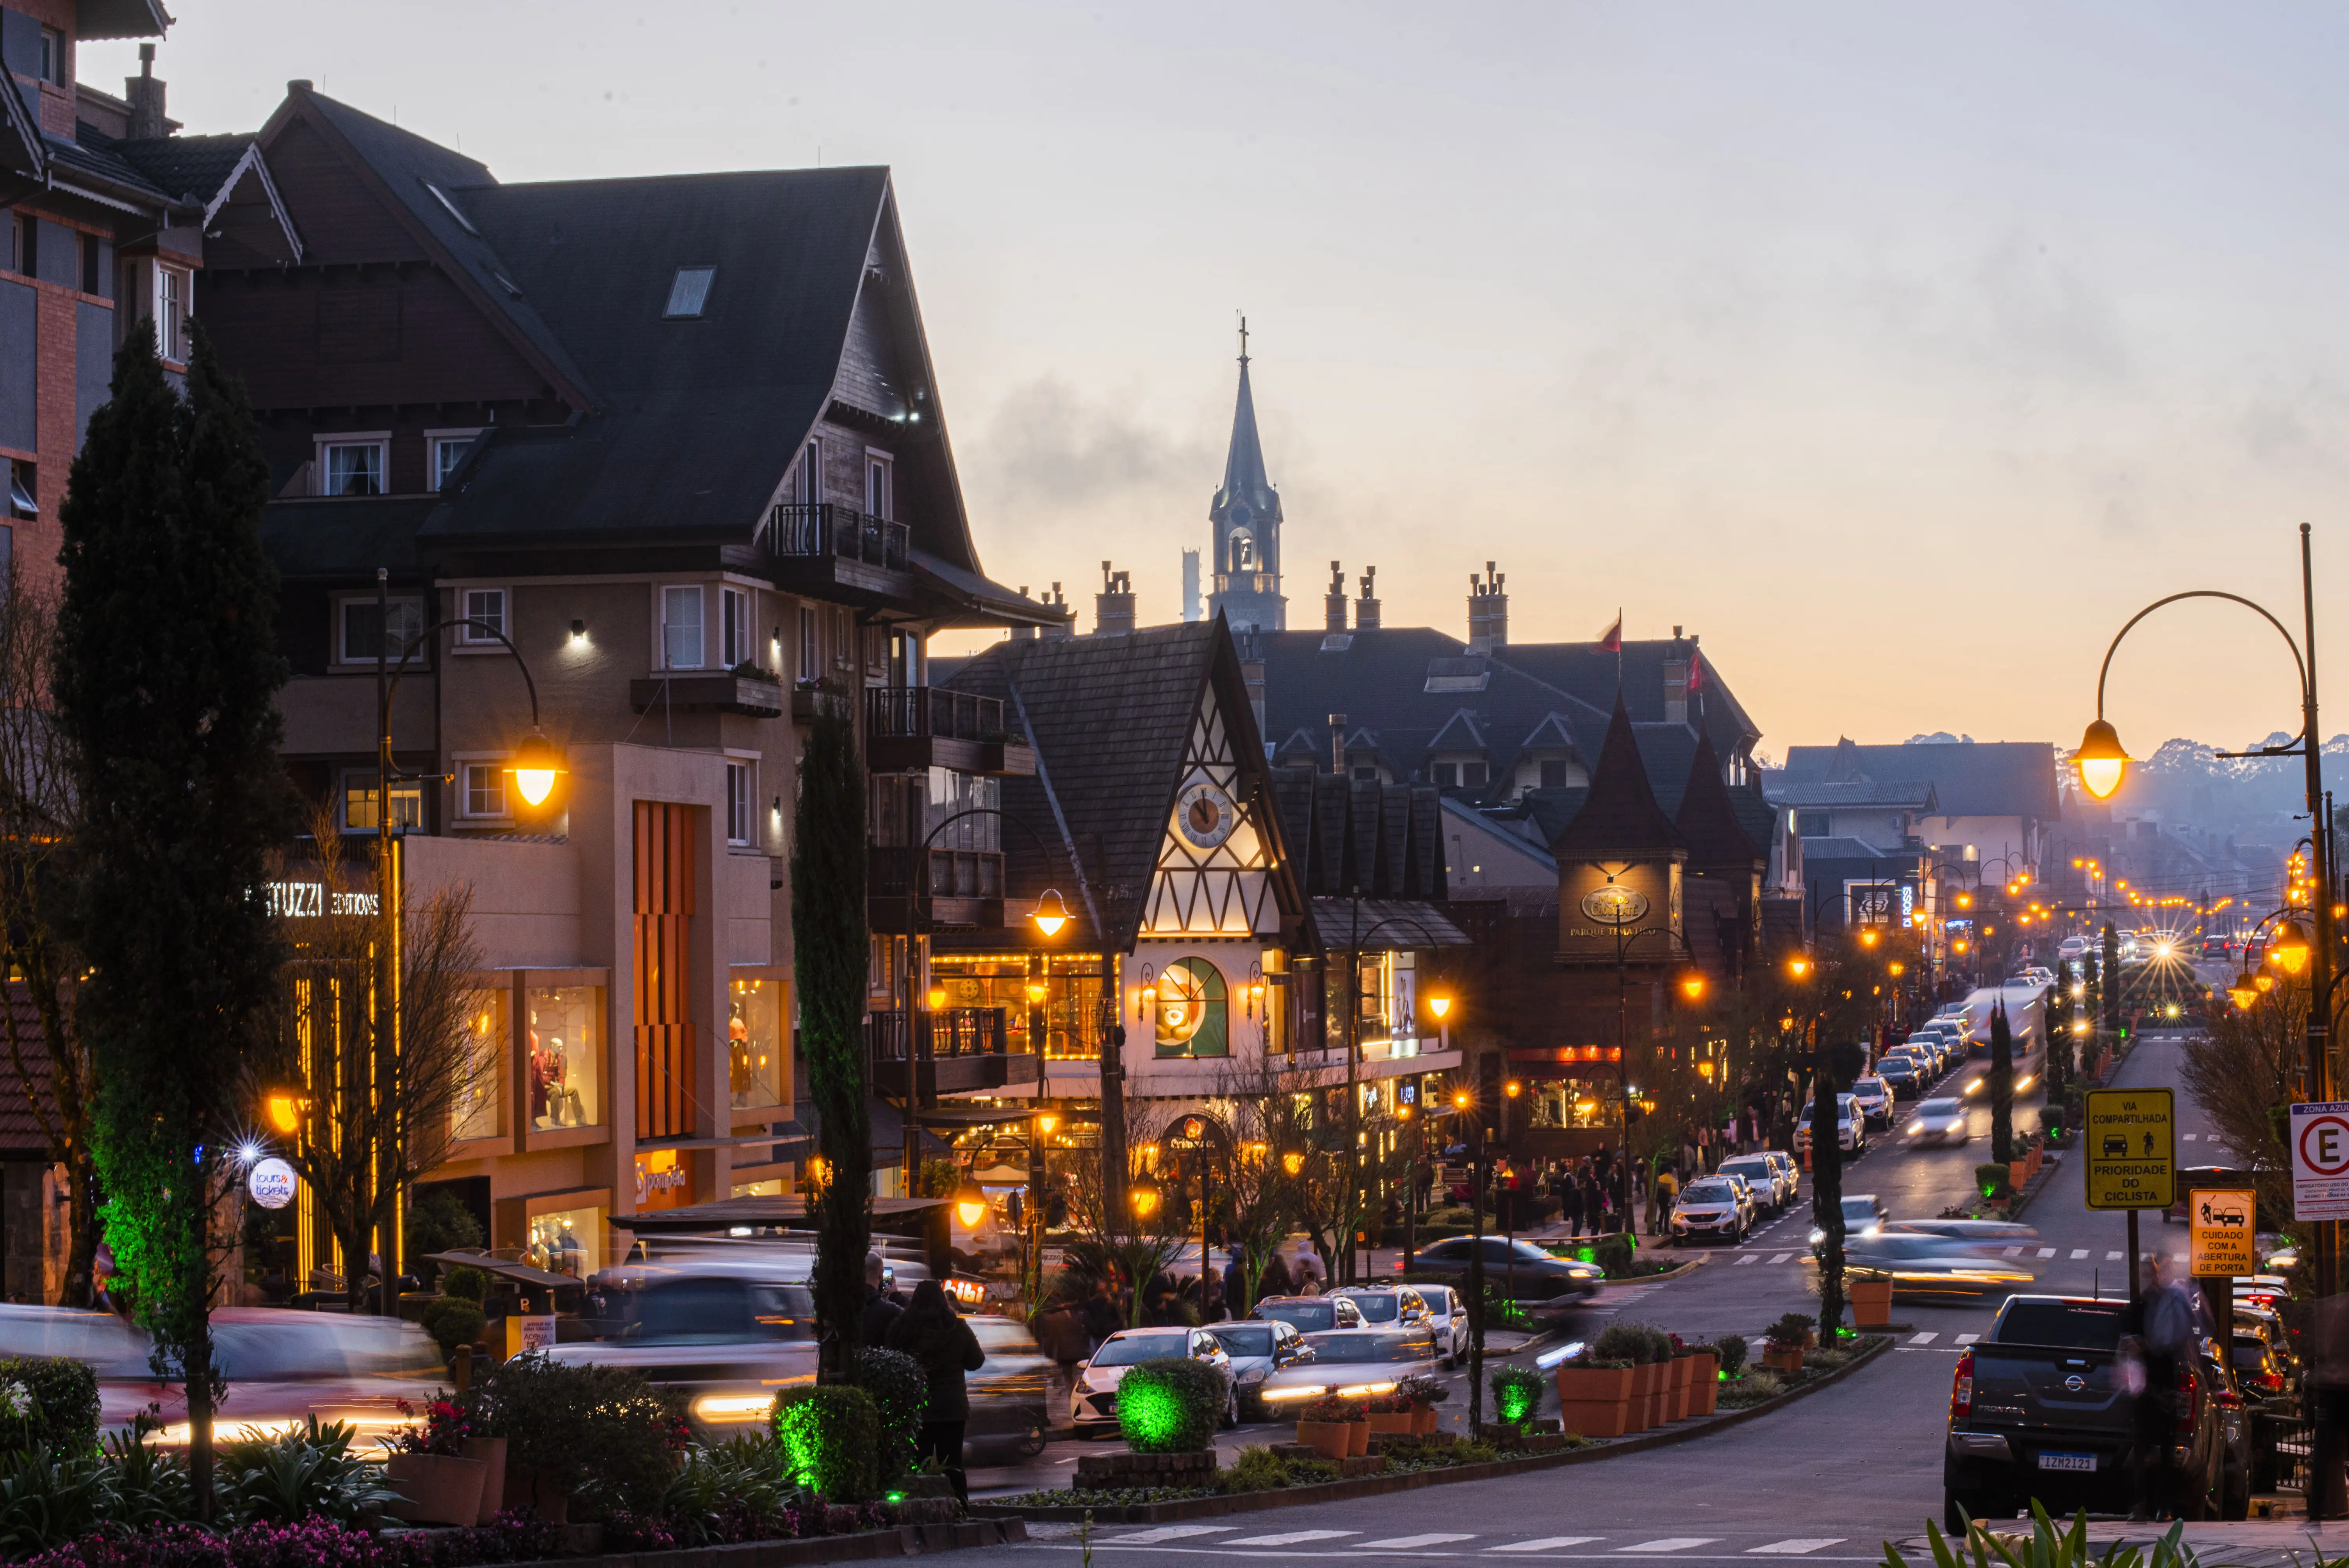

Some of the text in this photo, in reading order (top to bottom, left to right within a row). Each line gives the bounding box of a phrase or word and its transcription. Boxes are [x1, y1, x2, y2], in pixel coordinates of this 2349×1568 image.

[244, 882, 322, 917] TUZZI
[1903, 887, 1912, 915] ROSSI
[1570, 928, 1606, 937] PARQUE
[2123, 1101, 2137, 1110] VIA
[2303, 1105, 2327, 1113] ZONA
[2092, 1114, 2167, 1124] COMPARTILHADA
[2319, 1129, 2340, 1163] E
[2094, 1165, 2167, 1175] PRIORIDADE
[2122, 1178, 2139, 1188] DO
[256, 1184, 288, 1195] tickets
[2105, 1191, 2157, 1201] CICLISTA
[2202, 1231, 2244, 1239] CUIDADO
[2198, 1253, 2247, 1261] ABERTURA
[2215, 1263, 2245, 1272] PORTA
[520, 1298, 529, 1311] P
[1978, 1405, 2025, 1414] FRONTIER
[2045, 1456, 2091, 1470] IZM2I21
